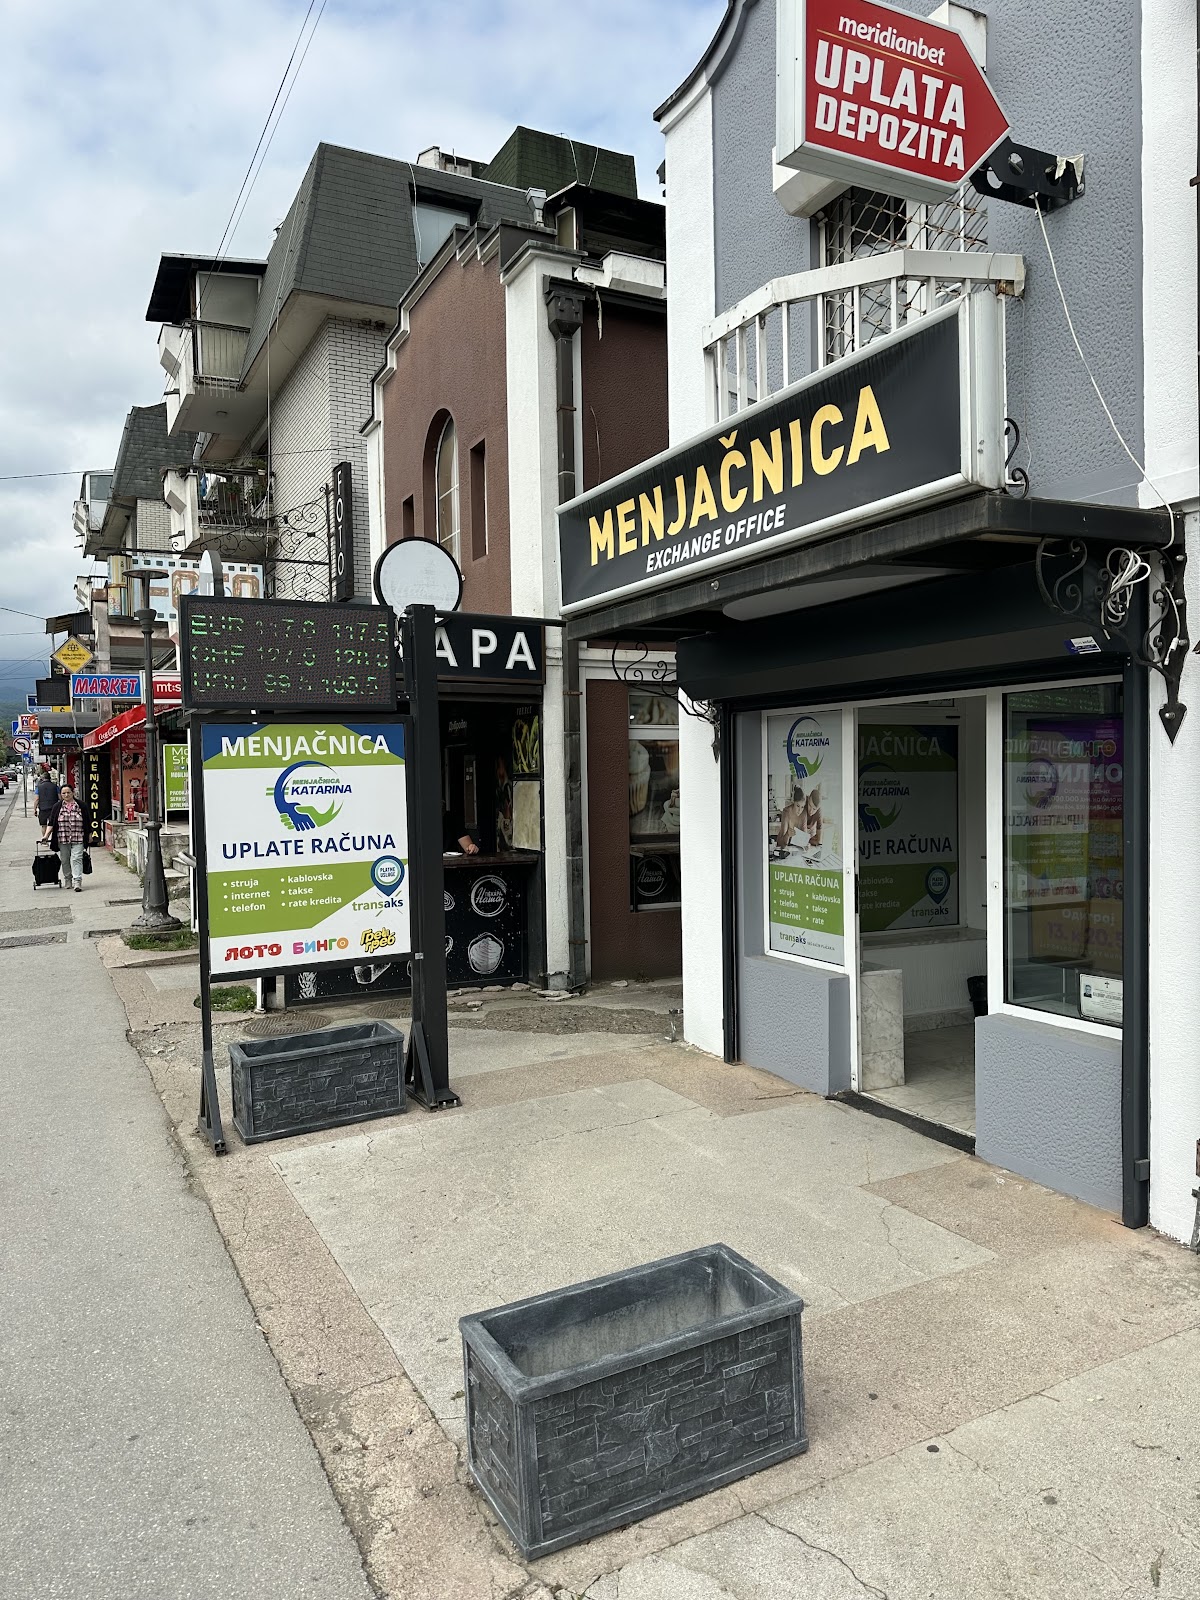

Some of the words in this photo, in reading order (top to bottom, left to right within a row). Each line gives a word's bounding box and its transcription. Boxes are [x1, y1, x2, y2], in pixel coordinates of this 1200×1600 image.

[838, 15, 946, 67] meridianbet
[814, 39, 966, 130] UPLATA
[814, 92, 965, 171] DEPOZITA
[588, 384, 891, 567] MENJAČNICA
[646, 528, 722, 573] EXCHANGE
[724, 504, 787, 546] OFFICE
[74, 677, 138, 696] MARKET
[221, 730, 390, 761] MENJAČNICA
[795, 737, 830, 747] KATARINA
[292, 776, 341, 785] MENJAČNICA
[291, 784, 352, 796] KATARINA
[862, 786, 910, 797] KATARINA
[222, 839, 304, 860] UPLATE
[311, 832, 396, 854] RAČUNA
[886, 834, 953, 855] RAČUNA
[230, 878, 259, 888] struja
[287, 873, 333, 883] kablovska
[774, 871, 803, 884] UPLATA
[805, 873, 839, 889] RAČUNA
[231, 890, 271, 900] internet
[288, 887, 313, 896] takse
[779, 888, 795, 897] struja
[812, 893, 841, 904] kablovska
[231, 903, 266, 913] telefon
[288, 900, 308, 908] rate
[309, 896, 342, 906] kredita
[352, 897, 404, 912] transaks
[779, 899, 799, 908] telefon
[812, 905, 828, 914] takse
[874, 900, 900, 909] kredita
[911, 905, 949, 917] transaks
[779, 910, 801, 921] internet
[812, 916, 825, 925] rate
[779, 931, 806, 945] transaks
[224, 943, 282, 962] ЛОТО
[292, 937, 349, 955] БИНГО
